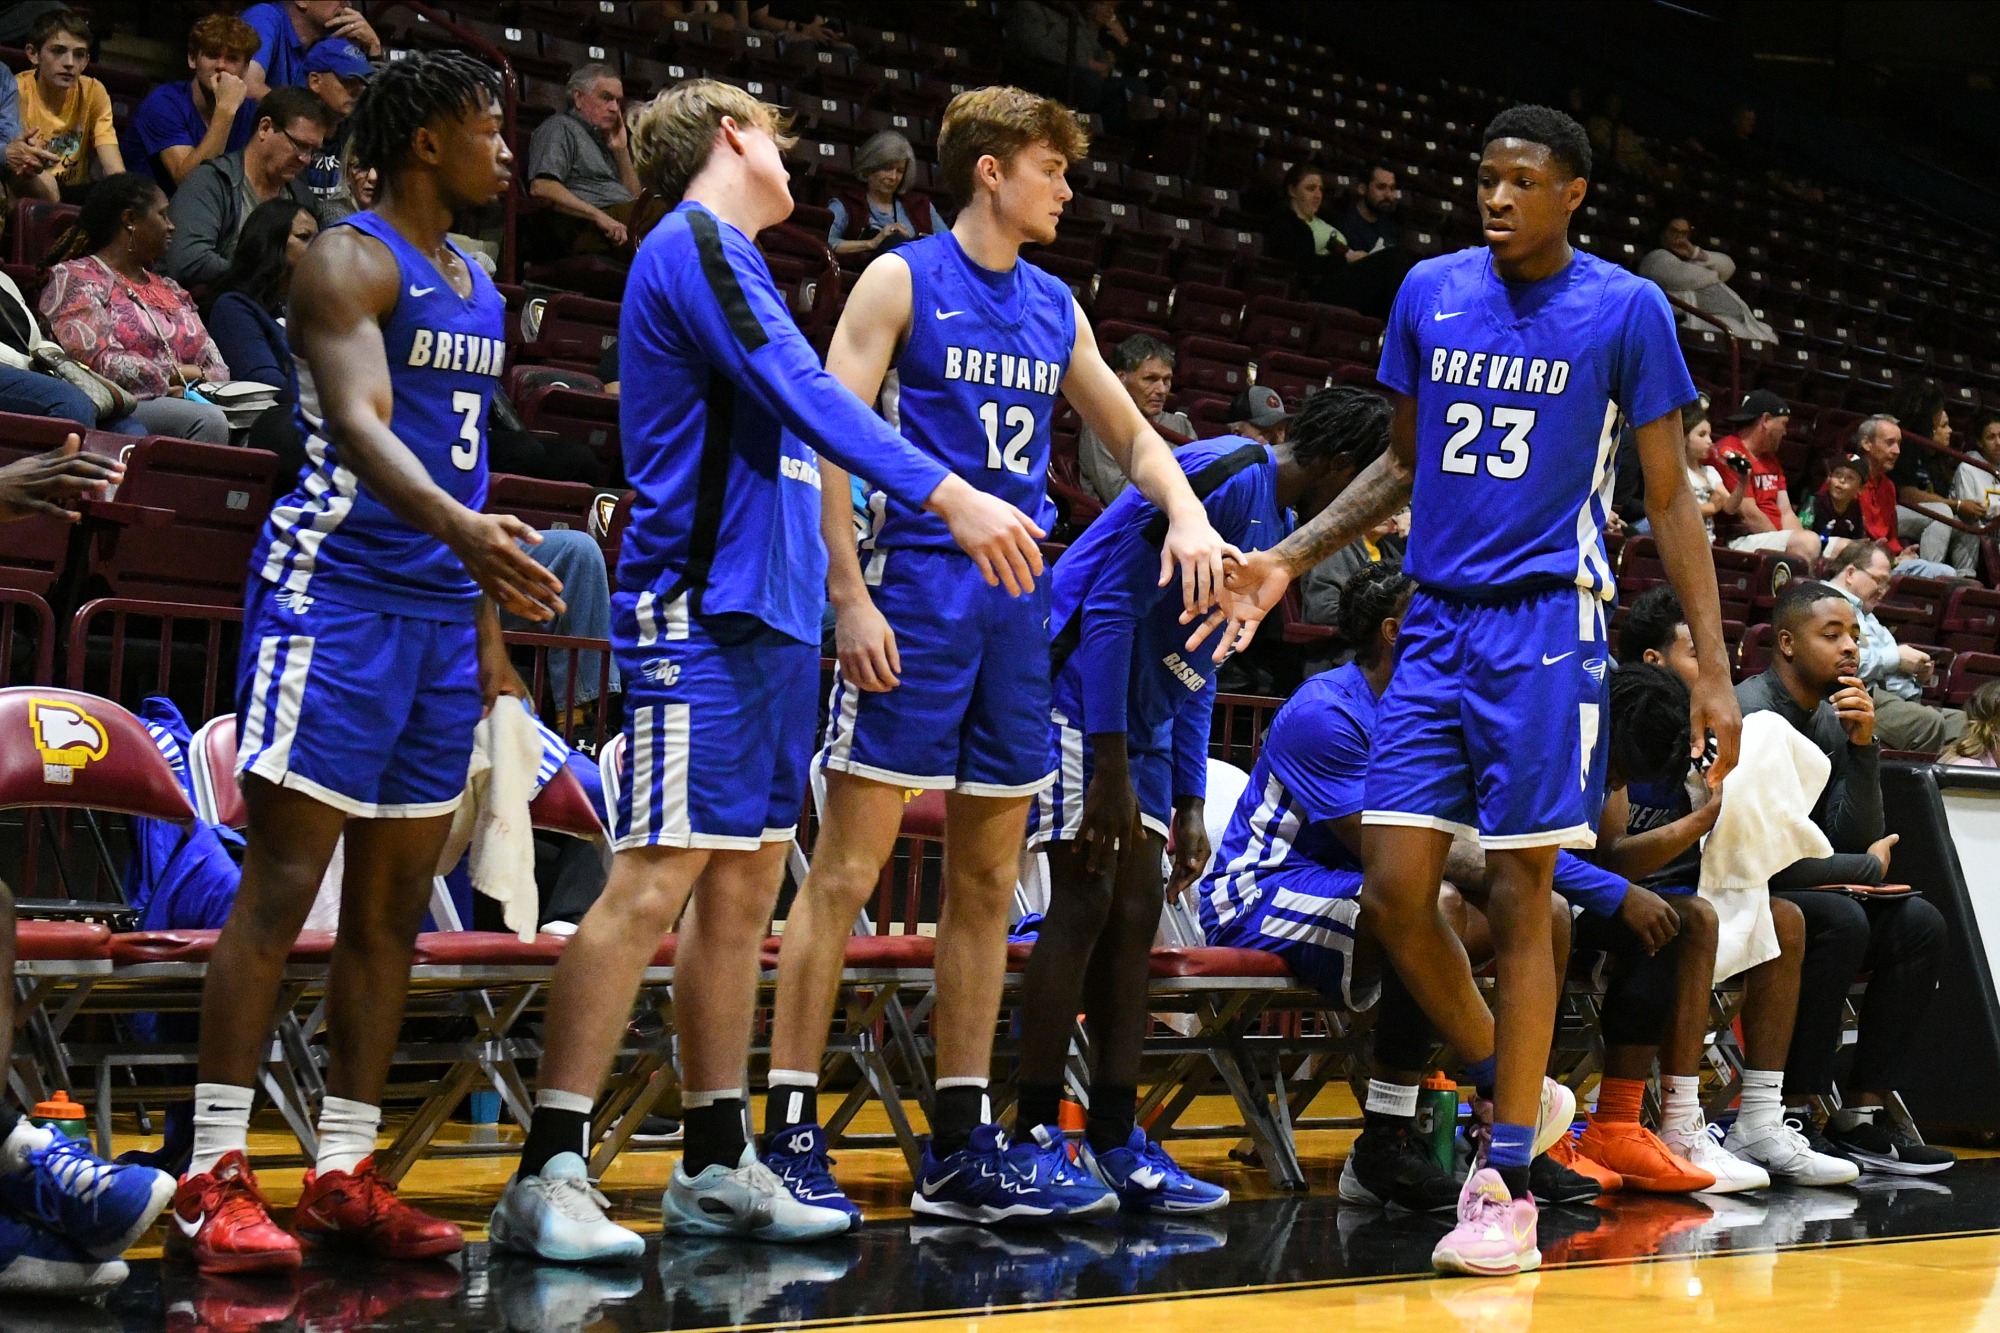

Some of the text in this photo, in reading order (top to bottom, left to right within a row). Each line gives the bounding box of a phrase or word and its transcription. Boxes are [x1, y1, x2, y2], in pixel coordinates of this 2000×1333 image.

[944, 345, 1061, 396] BREVARD
[1430, 346, 1570, 396] BREVARD
[451, 390, 482, 471] 3
[979, 401, 1035, 475] 12
[1441, 401, 1537, 480] 23
